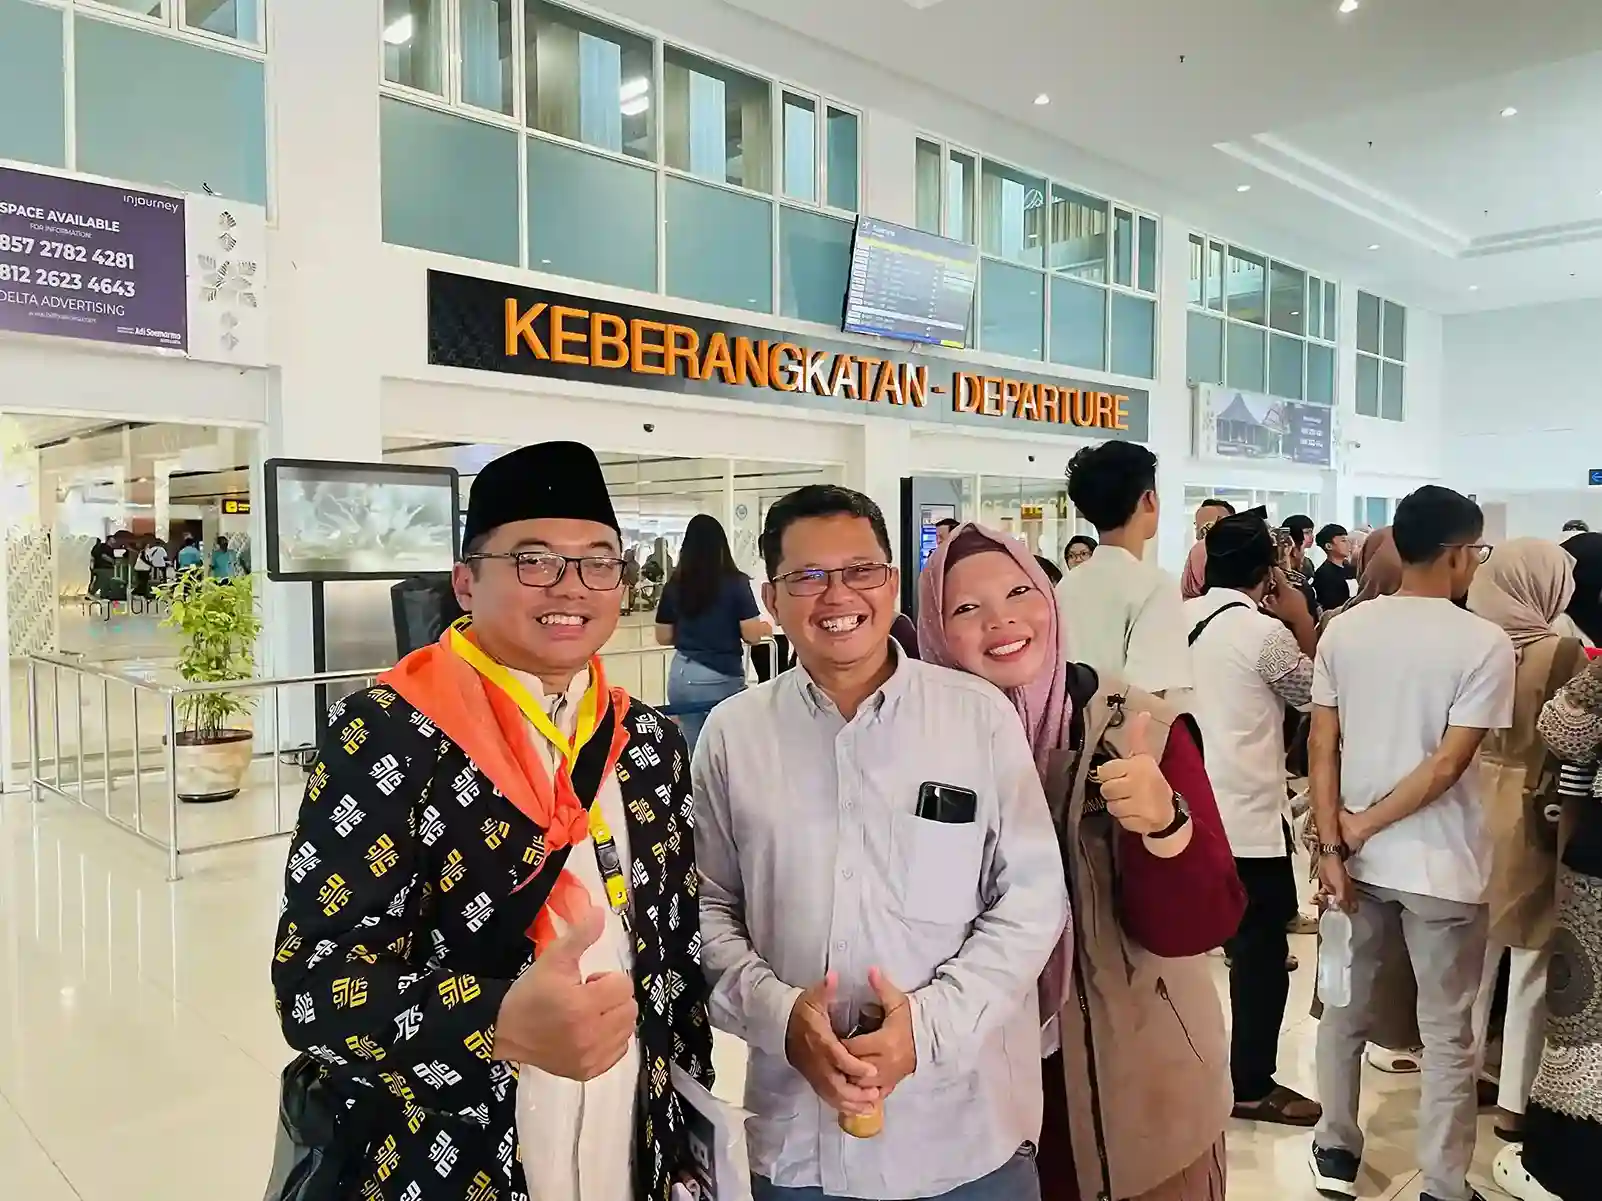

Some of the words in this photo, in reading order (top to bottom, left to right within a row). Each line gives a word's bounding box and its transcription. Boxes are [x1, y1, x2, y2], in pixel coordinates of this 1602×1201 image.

[0, 202, 45, 220] SPACE
[47, 210, 120, 232] AVAILABLE
[123, 195, 179, 214] injourney
[0, 233, 35, 254] 857
[39, 240, 88, 262] 2782
[91, 248, 134, 270] 4281
[0, 263, 31, 283] 812
[35, 268, 82, 290] 2623
[87, 276, 136, 297] 4643
[40, 296, 125, 316] ADVERTISING
[505, 298, 929, 408] KEBERANGKATAN
[953, 371, 1130, 431] DEPARTURE
